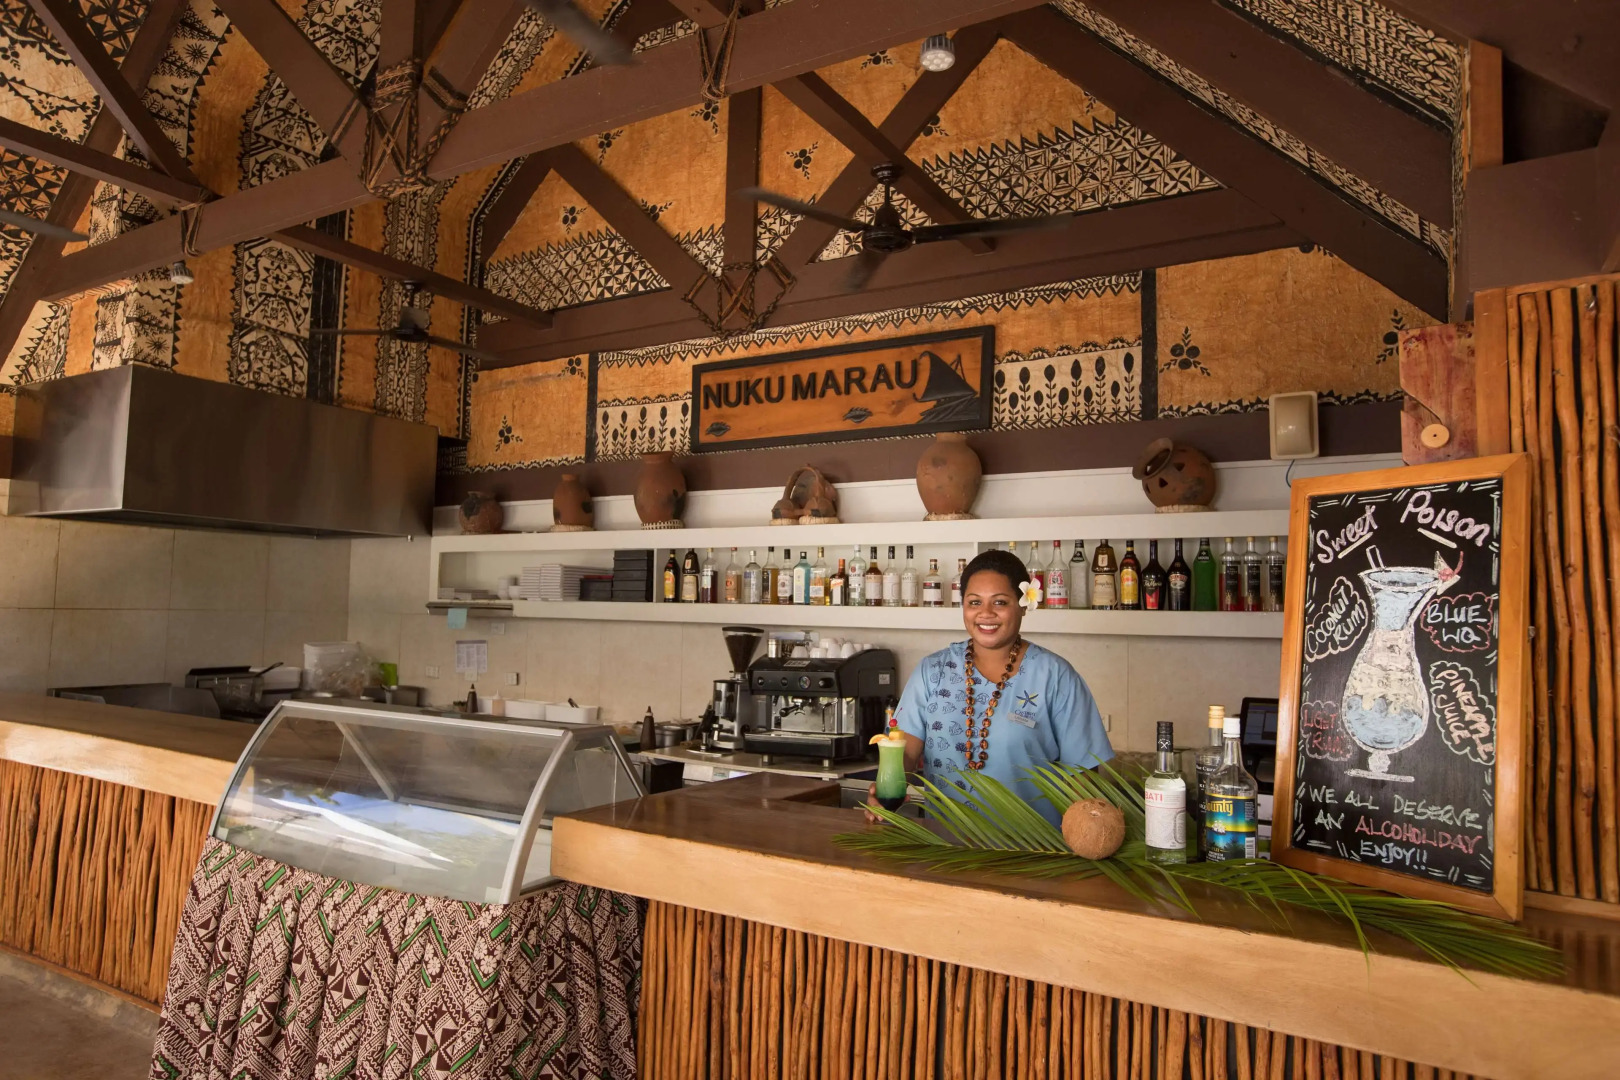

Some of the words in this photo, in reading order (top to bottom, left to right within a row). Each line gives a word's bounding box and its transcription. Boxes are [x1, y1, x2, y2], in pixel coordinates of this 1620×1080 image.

[703, 373, 784, 410] NUKU
[791, 359, 918, 401] MARAU
[1400, 490, 1491, 547] Poison
[1333, 604, 1365, 645] RUM
[1426, 603, 1487, 624] BLUE
[1435, 669, 1494, 761] PINEAPPLE
[1436, 694, 1472, 745] JUICE
[1309, 785, 1338, 804] WE
[1345, 790, 1379, 810] ALL
[1393, 794, 1482, 830] DESERVE
[1314, 809, 1345, 831] AN
[1355, 815, 1483, 855] ALCOHOLIDAY
[1361, 839, 1428, 870] ENJOY!!
